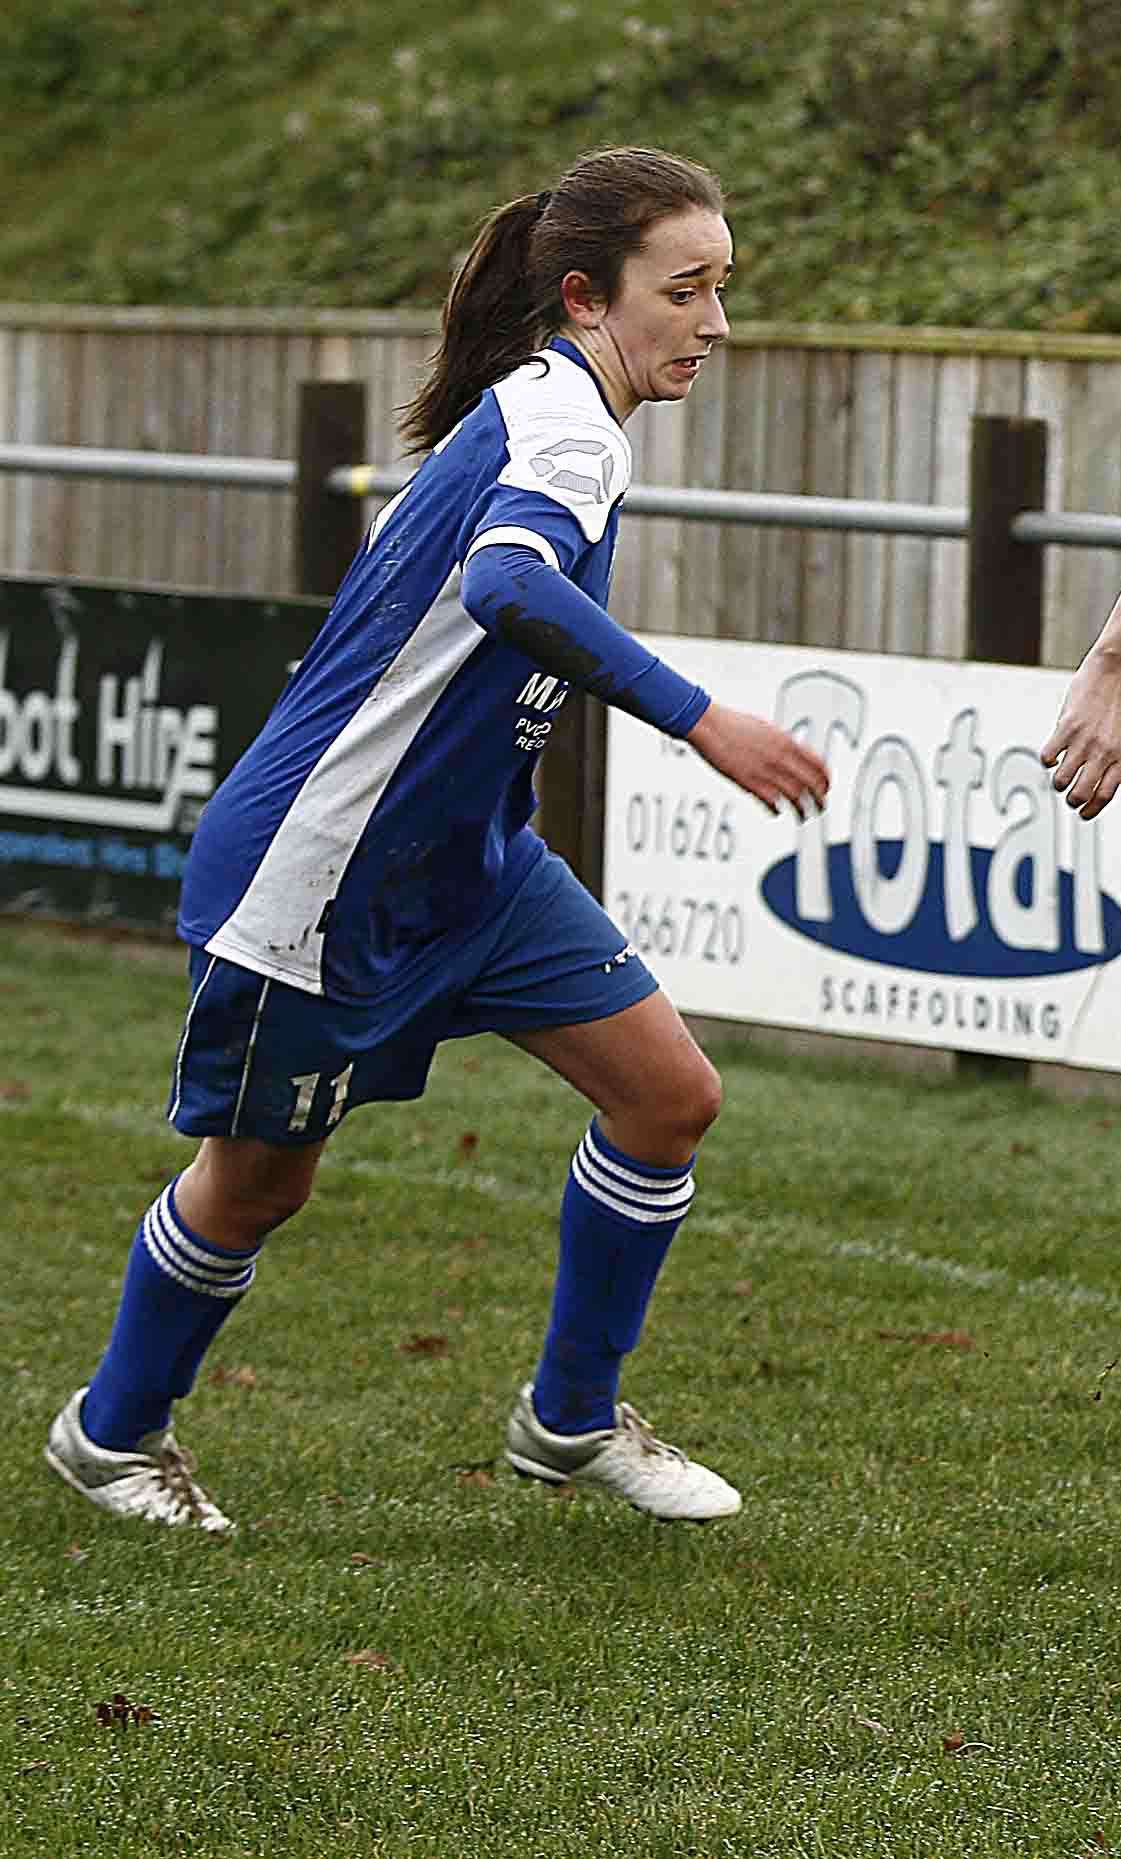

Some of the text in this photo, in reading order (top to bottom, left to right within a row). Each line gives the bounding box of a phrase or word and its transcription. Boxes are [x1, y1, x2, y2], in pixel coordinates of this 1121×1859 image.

[98, 638, 217, 796] Hire
[626, 793, 736, 862] 01626
[777, 669, 1105, 956] Total
[820, 975, 1061, 1040] SCAFFOLDING
[289, 1062, 354, 1132] 11
